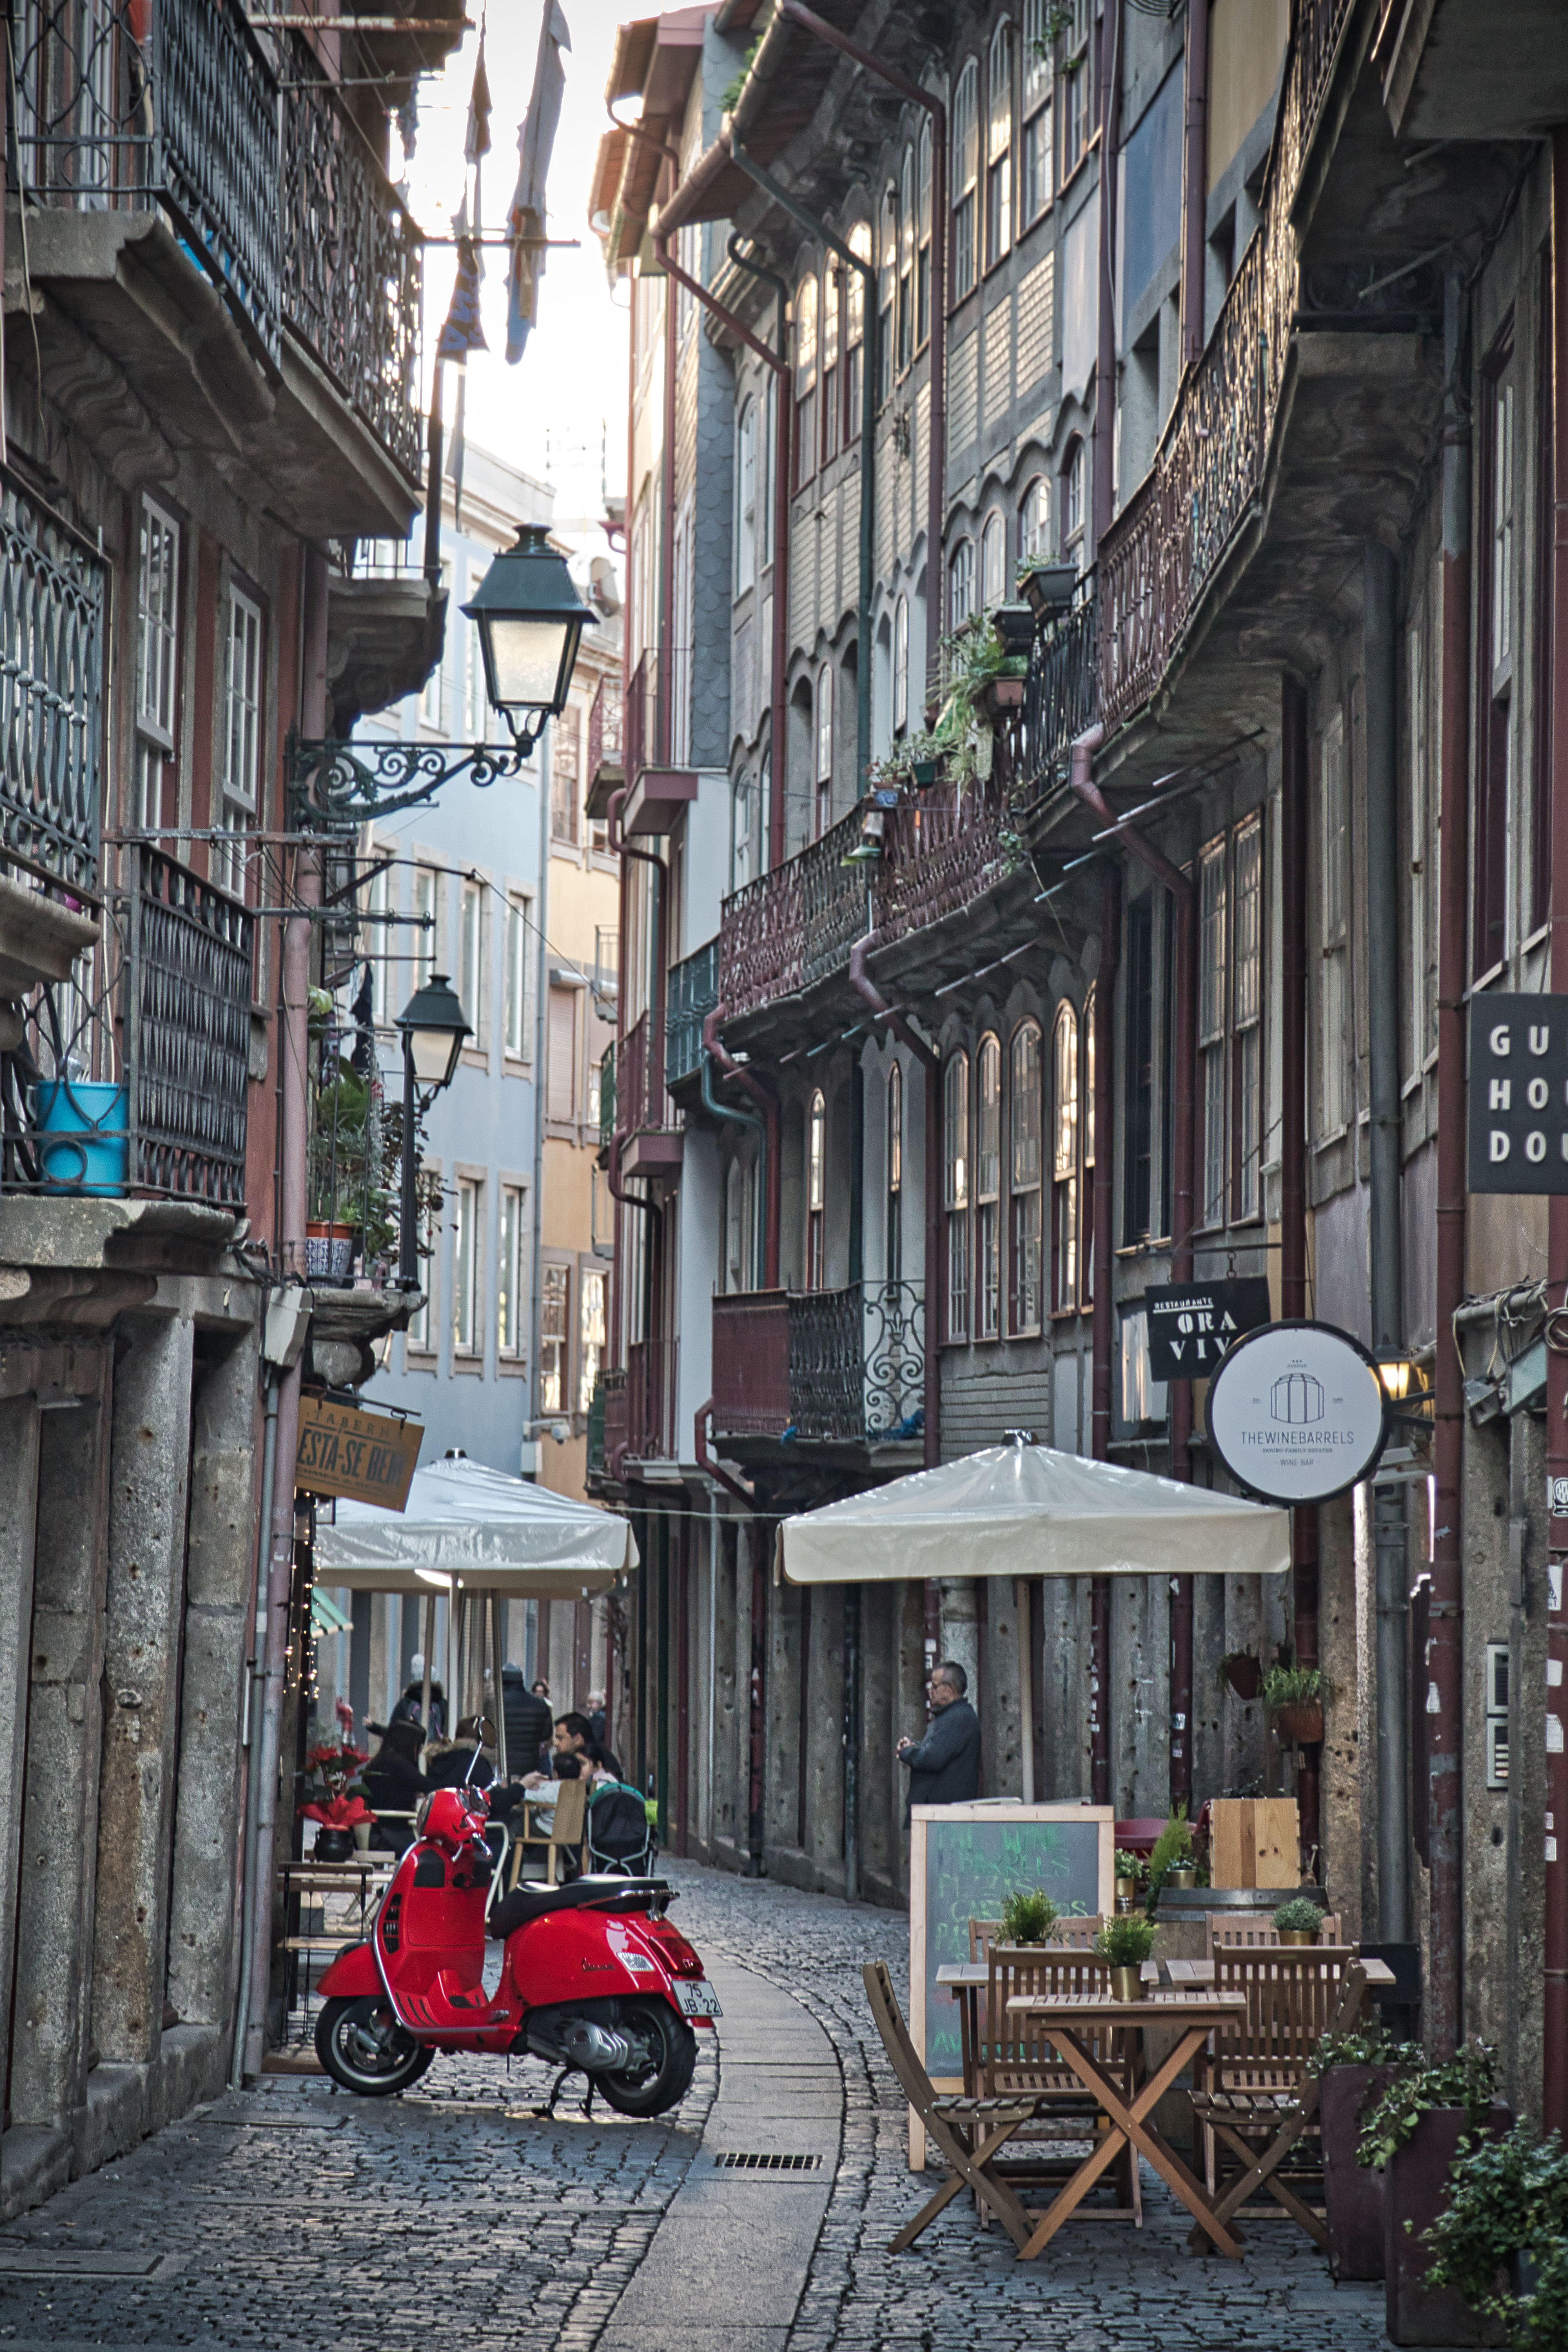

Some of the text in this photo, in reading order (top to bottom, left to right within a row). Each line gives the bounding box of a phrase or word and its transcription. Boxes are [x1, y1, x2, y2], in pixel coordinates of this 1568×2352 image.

[1489, 1077, 1568, 1110] HO
[1154, 1297, 1213, 1310] RESTAURANTE
[1177, 1310, 1237, 1334] ORA
[1169, 1336, 1231, 1361] VIV
[315, 1410, 390, 1437] TABERN
[1241, 1431, 1354, 1445] THEWINEBARRELS
[1280, 1458, 1314, 1466] WINE BAR
[686, 1983, 702, 1998] 75
